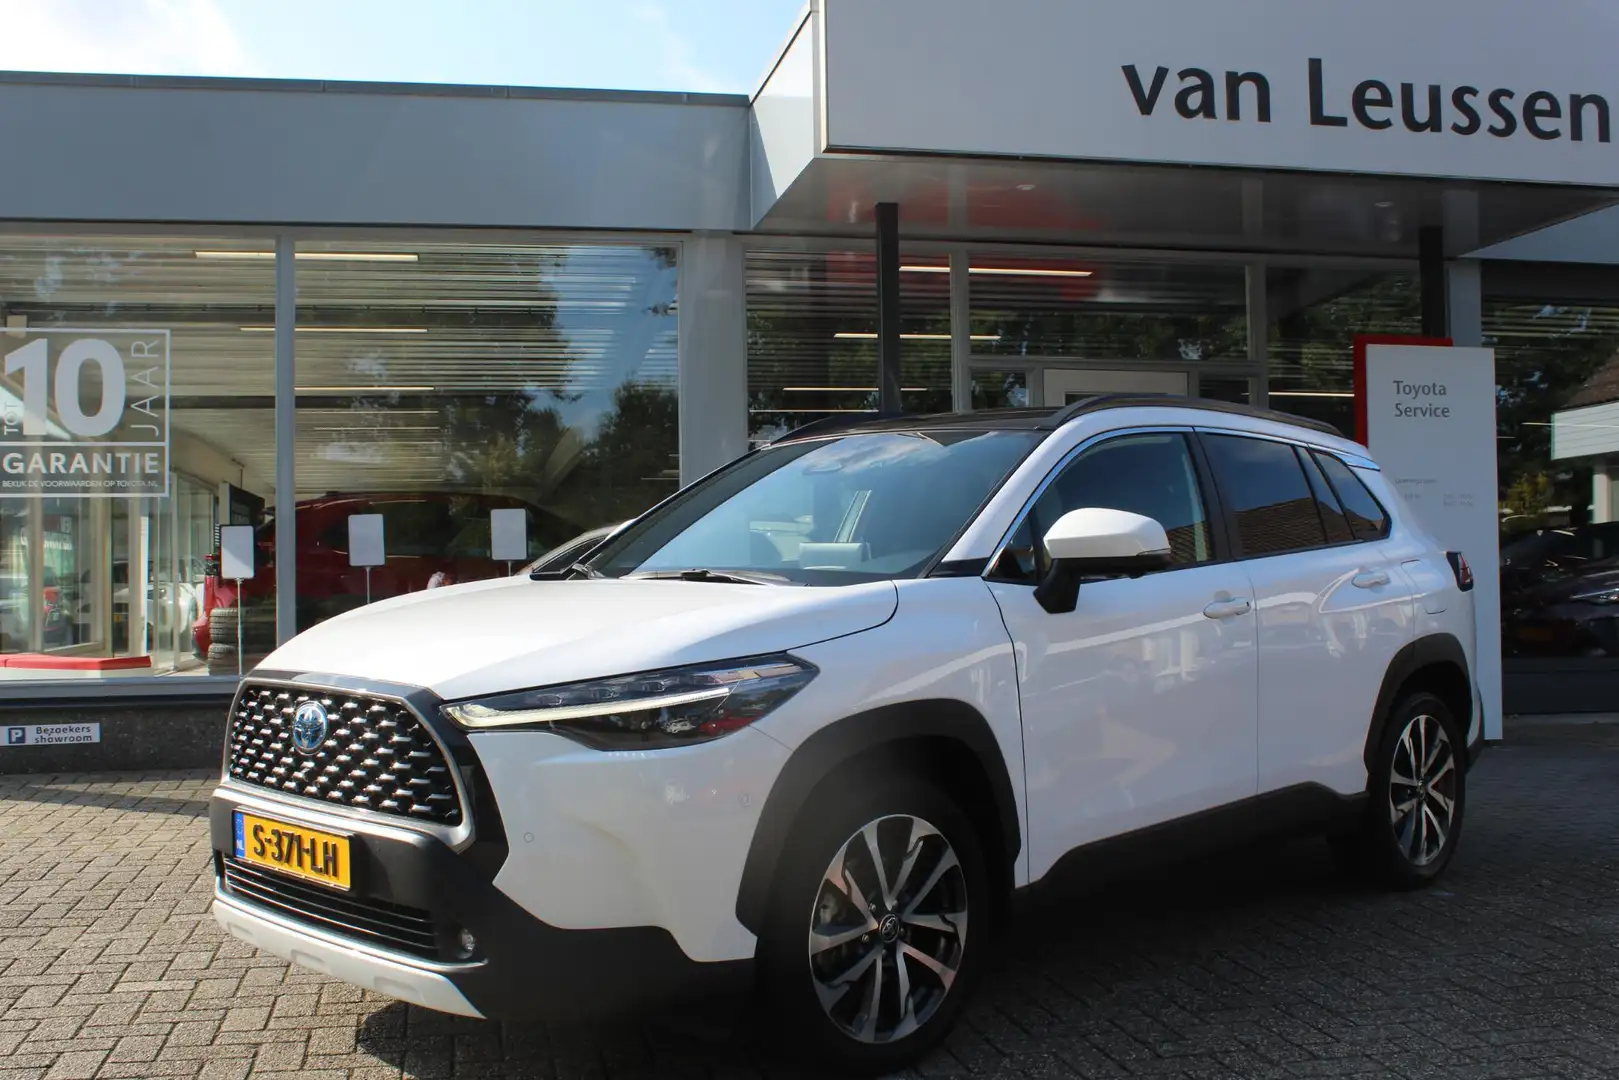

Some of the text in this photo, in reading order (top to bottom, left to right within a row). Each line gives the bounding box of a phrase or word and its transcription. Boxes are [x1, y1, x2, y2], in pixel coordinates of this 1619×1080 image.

[1121, 57, 1611, 143] van Leussen
[4, 338, 127, 437] 10
[130, 339, 160, 437] JAAR
[1393, 380, 1447, 399] Toyota
[3, 401, 19, 436] TOT
[1394, 403, 1450, 418] Service
[2, 452, 159, 474] GARANTIE
[34, 735, 92, 744] showroom
[36, 725, 91, 735] Bezoekers
[252, 823, 338, 878] S-371-LH
